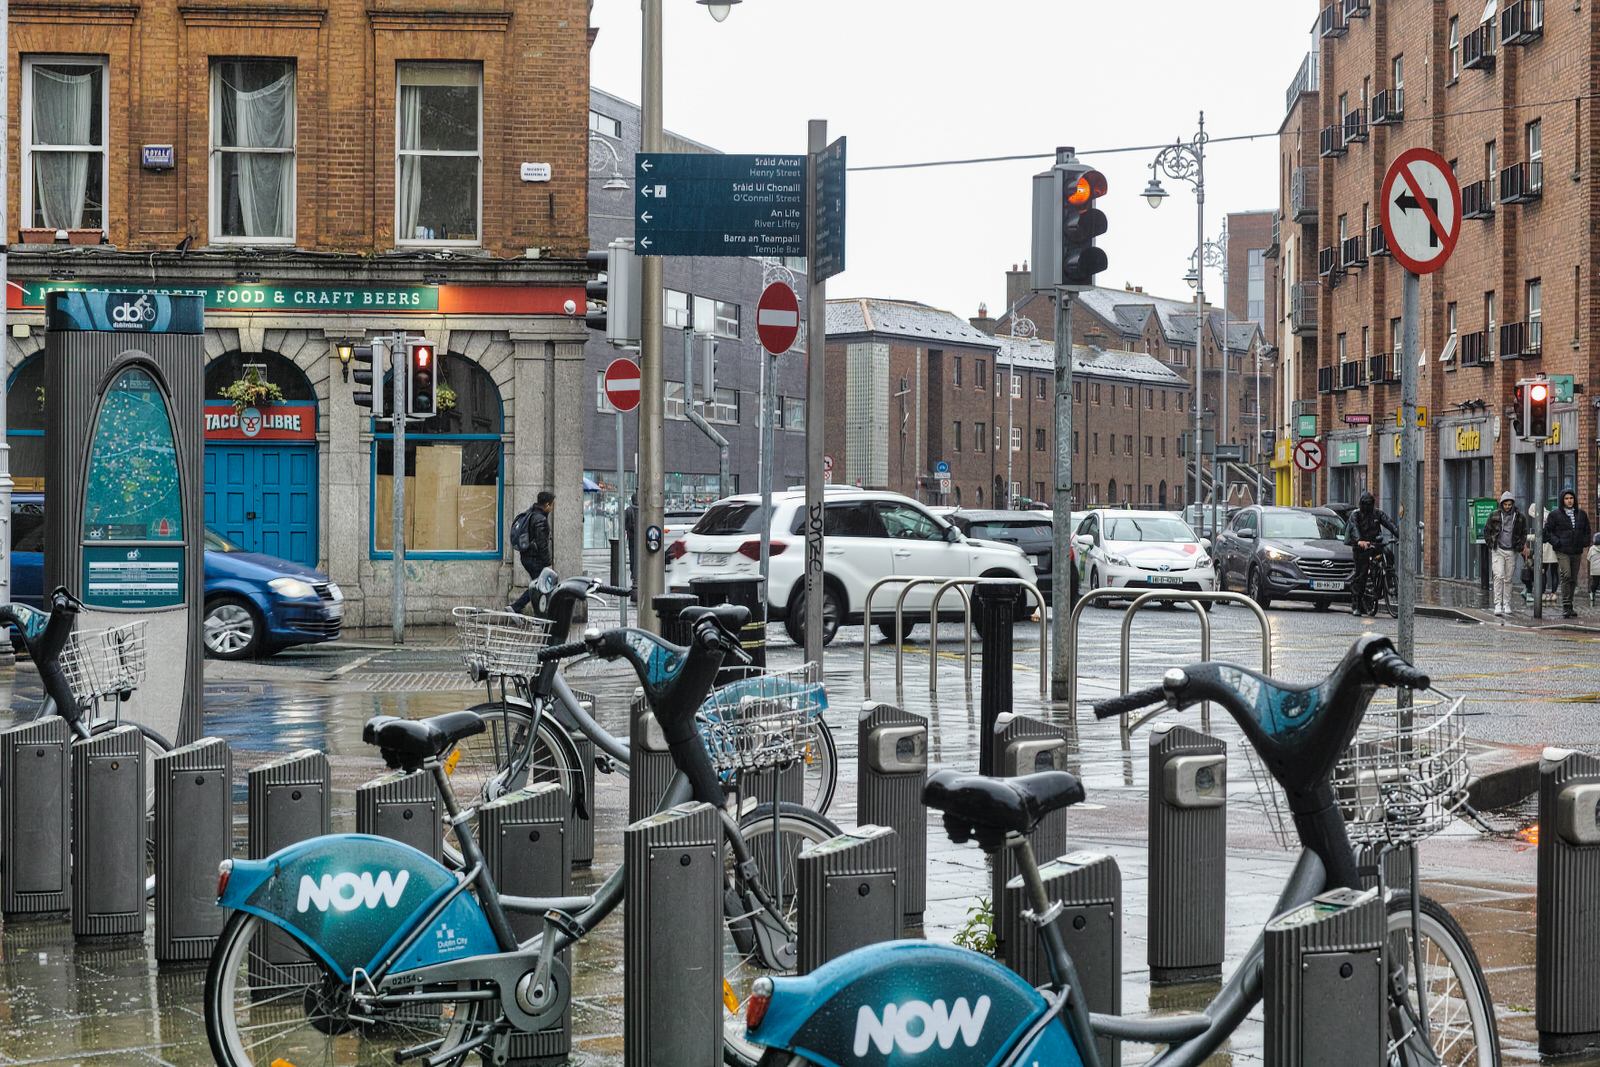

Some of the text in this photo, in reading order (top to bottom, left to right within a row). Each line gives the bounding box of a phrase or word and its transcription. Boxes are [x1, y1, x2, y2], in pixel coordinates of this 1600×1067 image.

[749, 168, 801, 178] Henry Street
[766, 183, 801, 192] Chonaill
[733, 193, 801, 203] O'Connell Street
[771, 208, 801, 218] An Life
[754, 219, 801, 230] River Liffey
[723, 233, 801, 244] Barra an Teampaill
[754, 245, 801, 255] Temple Bar
[216, 289, 266, 304] FOOD
[273, 290, 286, 304] &
[293, 291, 355, 305] CRAFT
[362, 292, 421, 305] BEERS
[204, 413, 302, 432] TACO LIBRE
[1456, 425, 1480, 452] Centra
[297, 869, 410, 913] NOW
[437, 939, 456, 949] Dublin
[456, 937, 468, 945] City
[392, 974, 416, 985] 02154
[853, 995, 991, 1057] NOW
